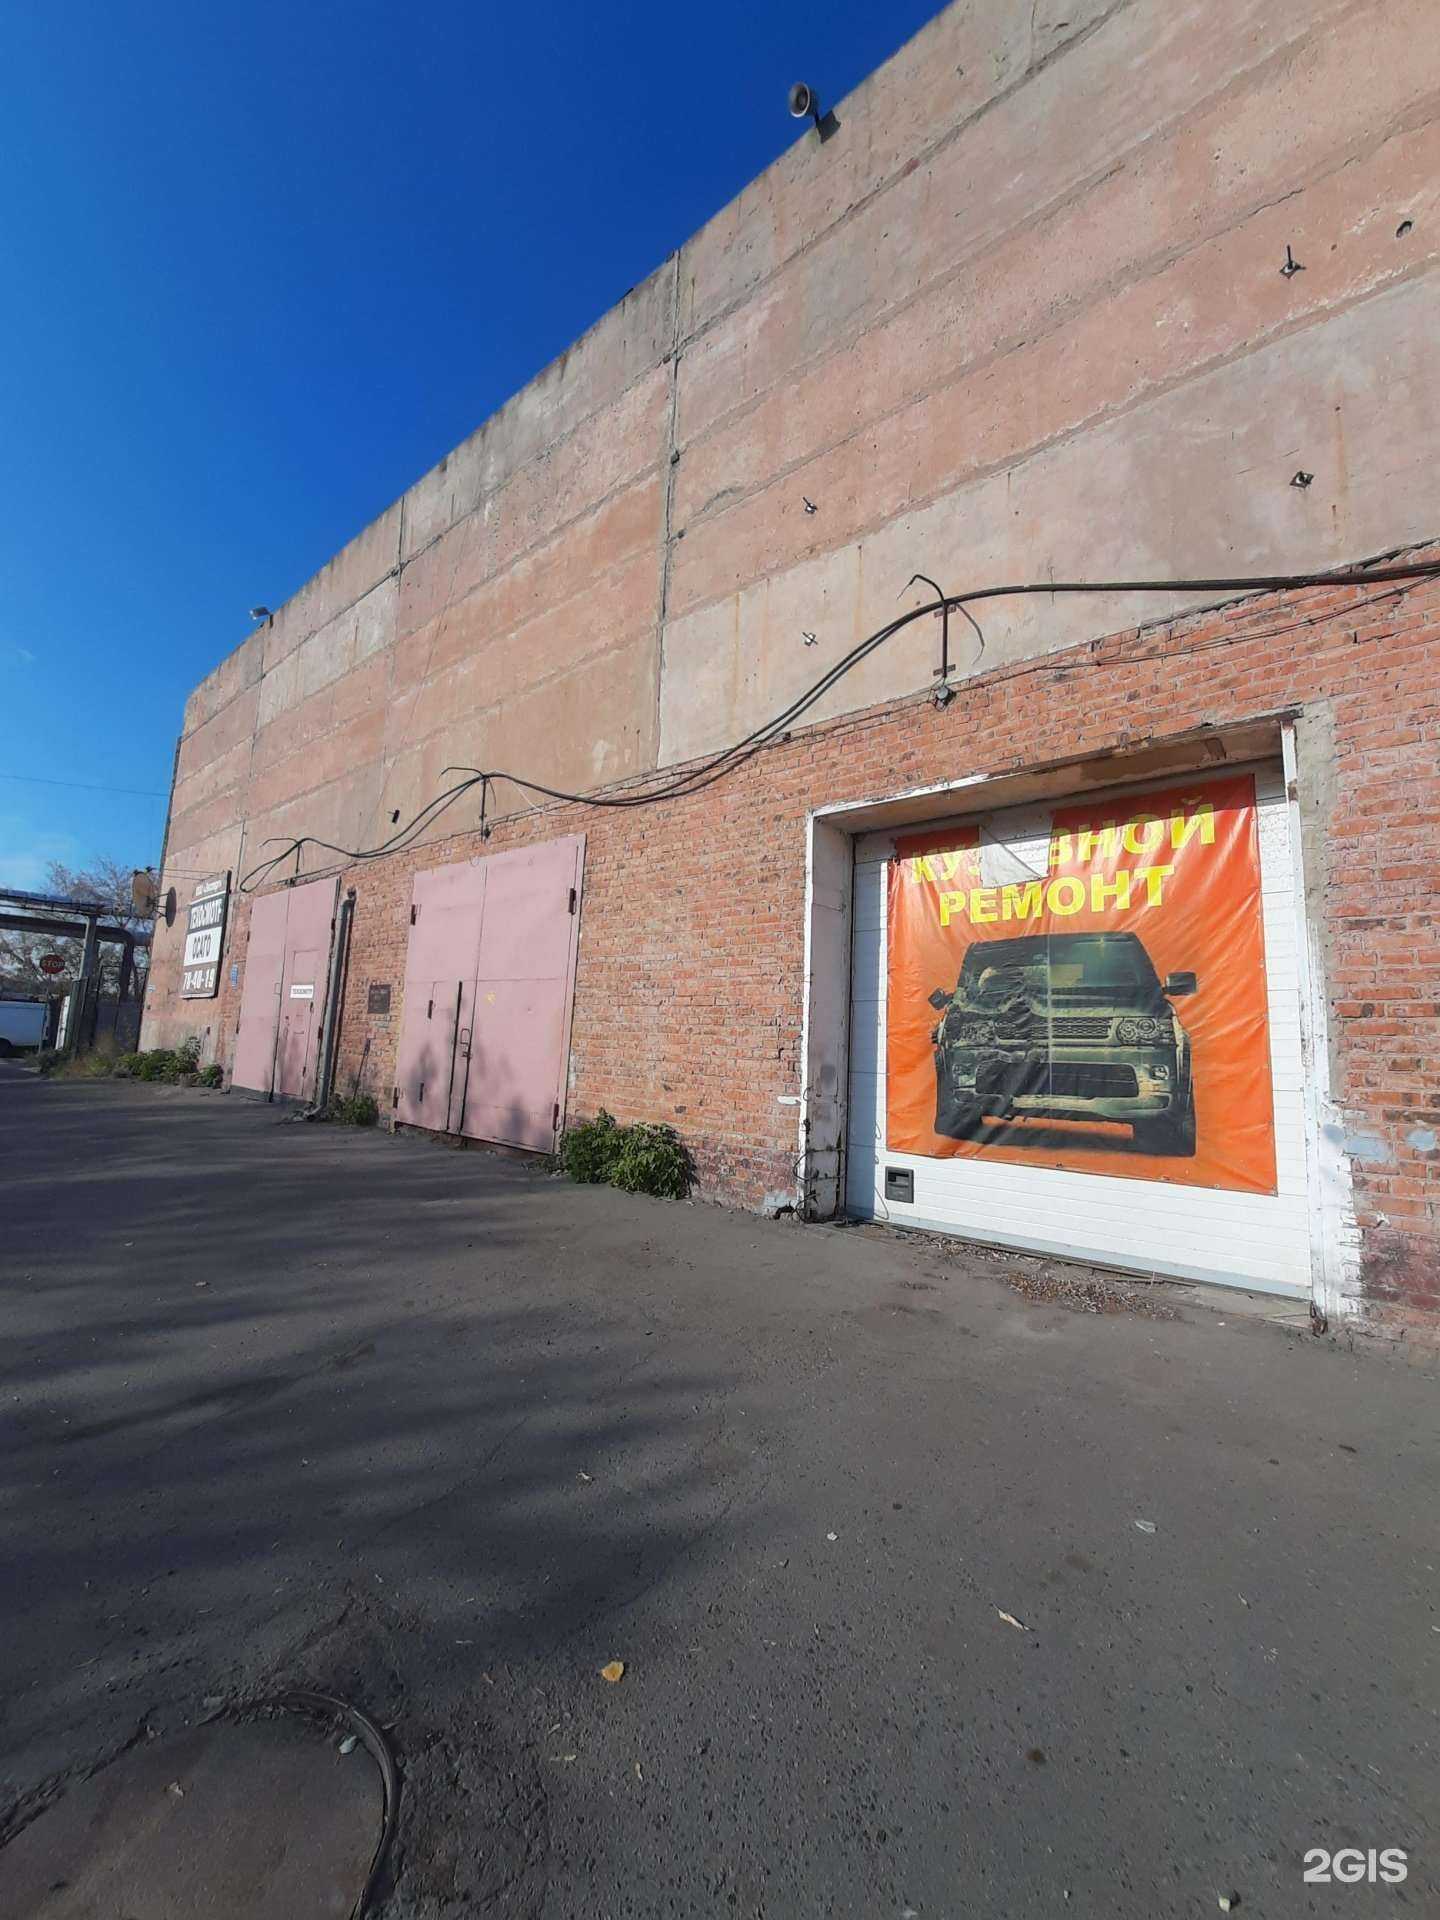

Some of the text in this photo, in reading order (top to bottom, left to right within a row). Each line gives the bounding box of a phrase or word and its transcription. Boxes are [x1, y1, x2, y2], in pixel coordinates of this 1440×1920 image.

[939, 864, 1175, 927] РЕМОНТ
[192, 933, 211, 959] ОСАГО
[41, 959, 65, 970] STOP
